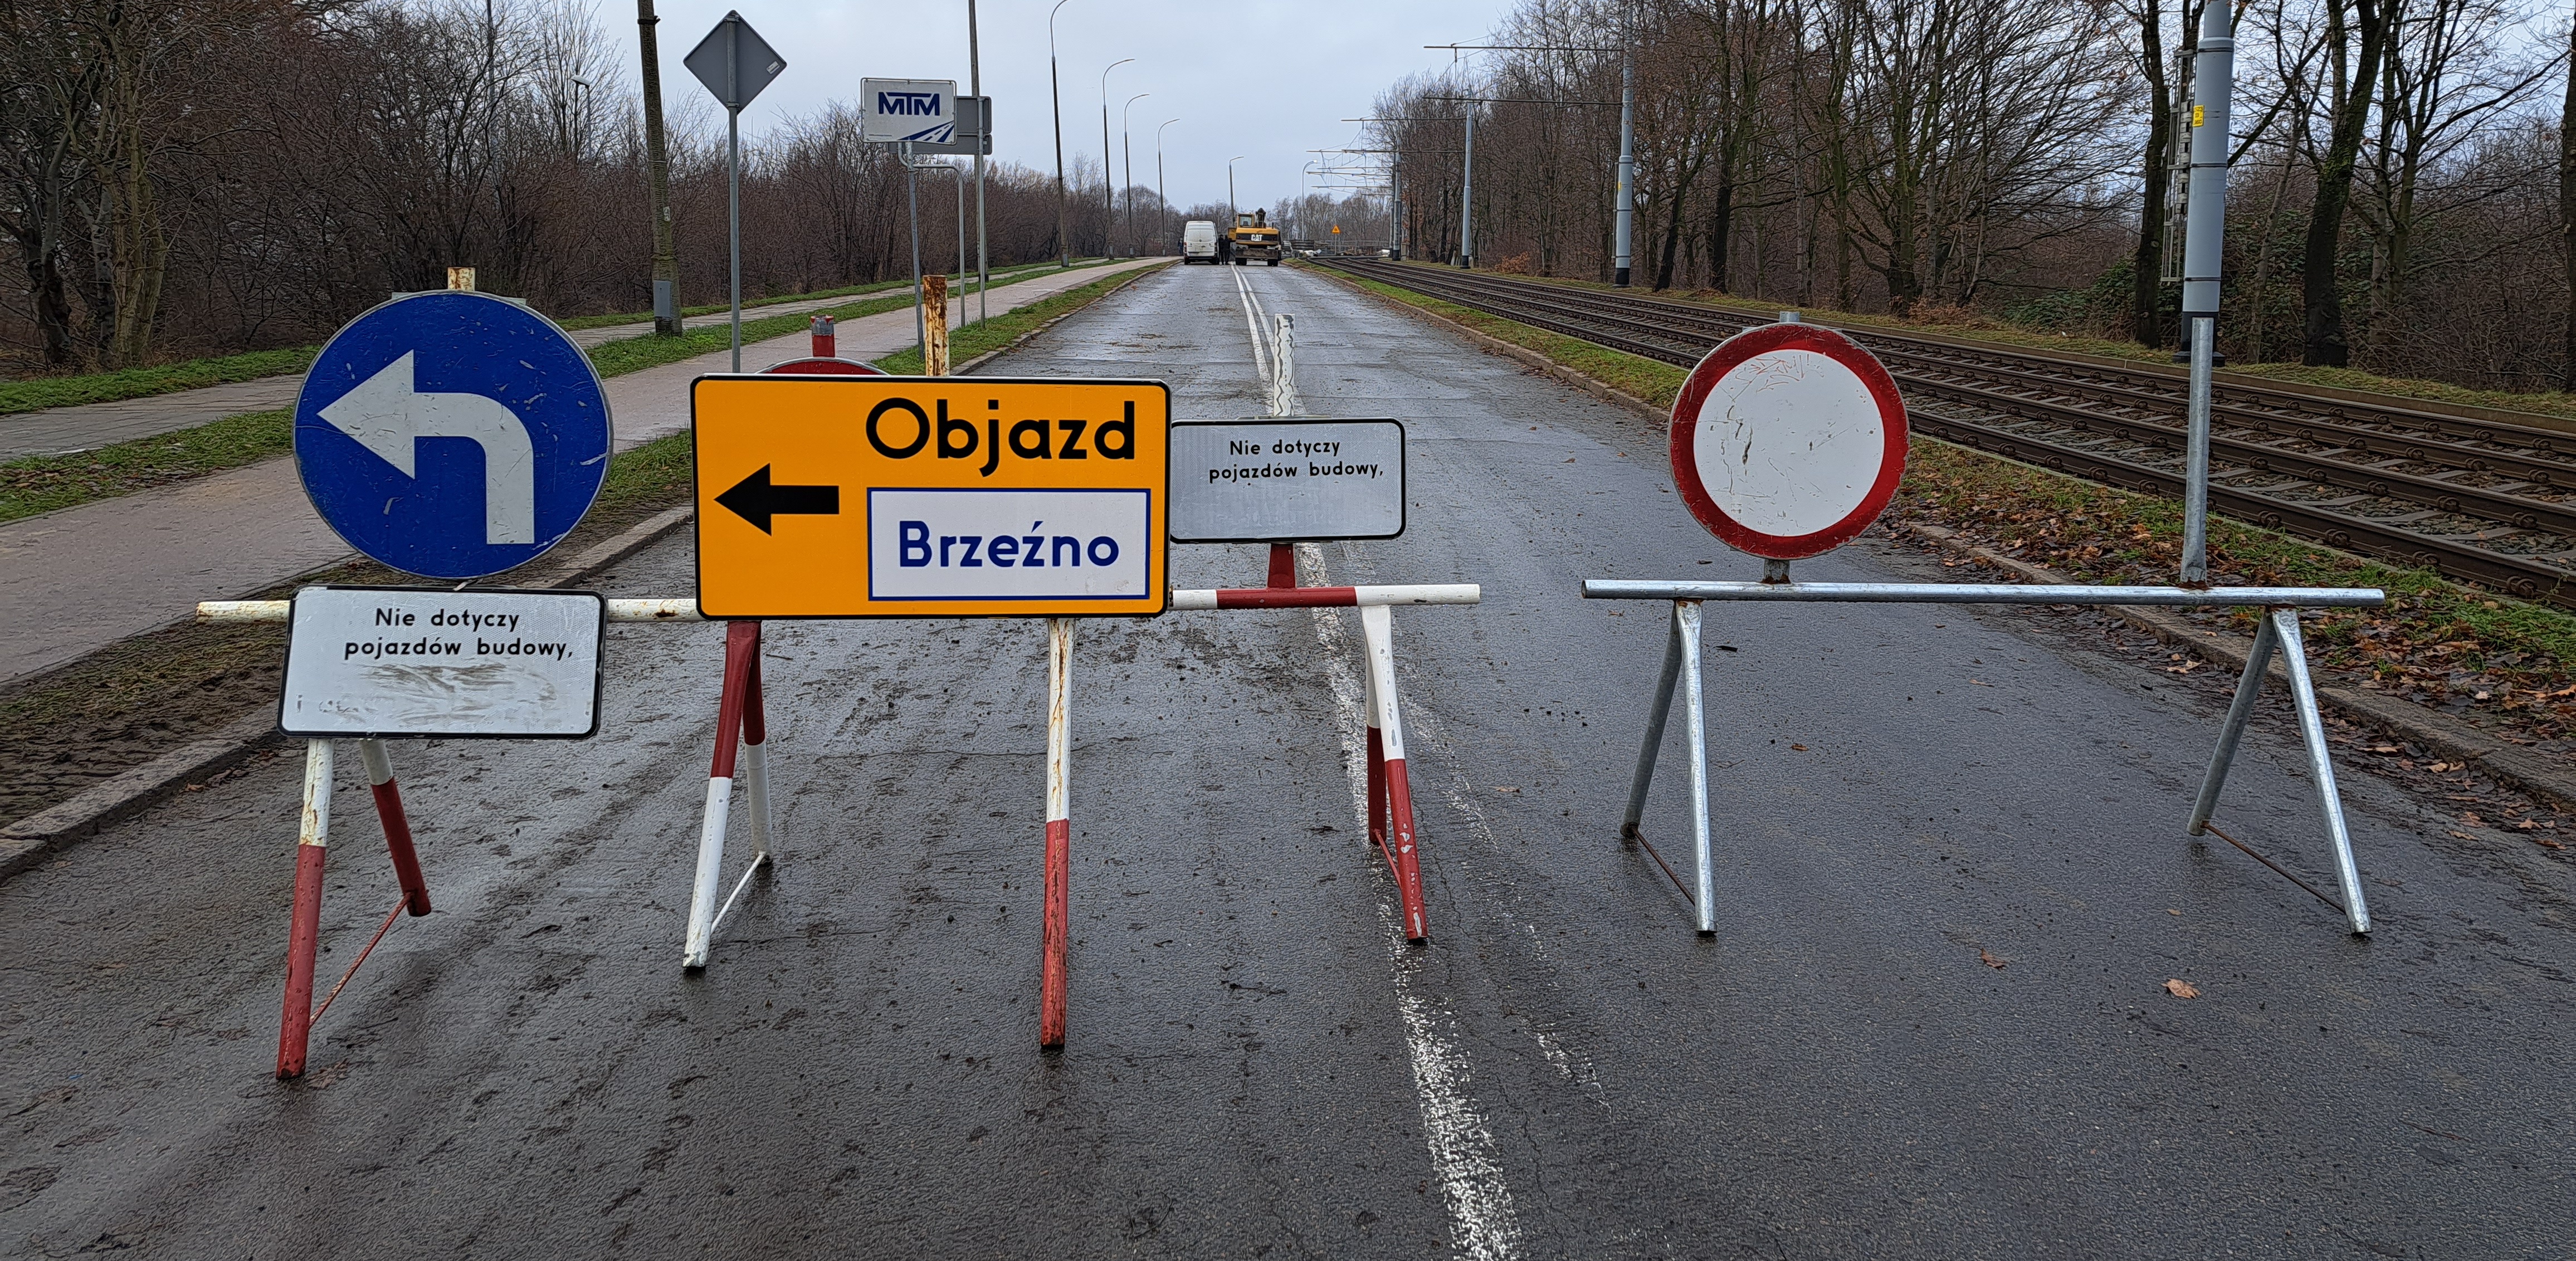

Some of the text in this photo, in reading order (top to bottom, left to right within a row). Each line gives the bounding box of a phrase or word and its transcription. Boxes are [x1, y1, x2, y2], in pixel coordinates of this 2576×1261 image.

[878, 91, 940, 116] MTM
[866, 397, 1135, 477] Objazd
[1230, 438, 1340, 458] Nie dotyczy
[1209, 461, 1384, 484] pojazdów budowy,
[899, 520, 1120, 568] Brzeźno
[375, 608, 520, 633] Nie dotyczy
[344, 637, 573, 661] pojazdów budowy,
